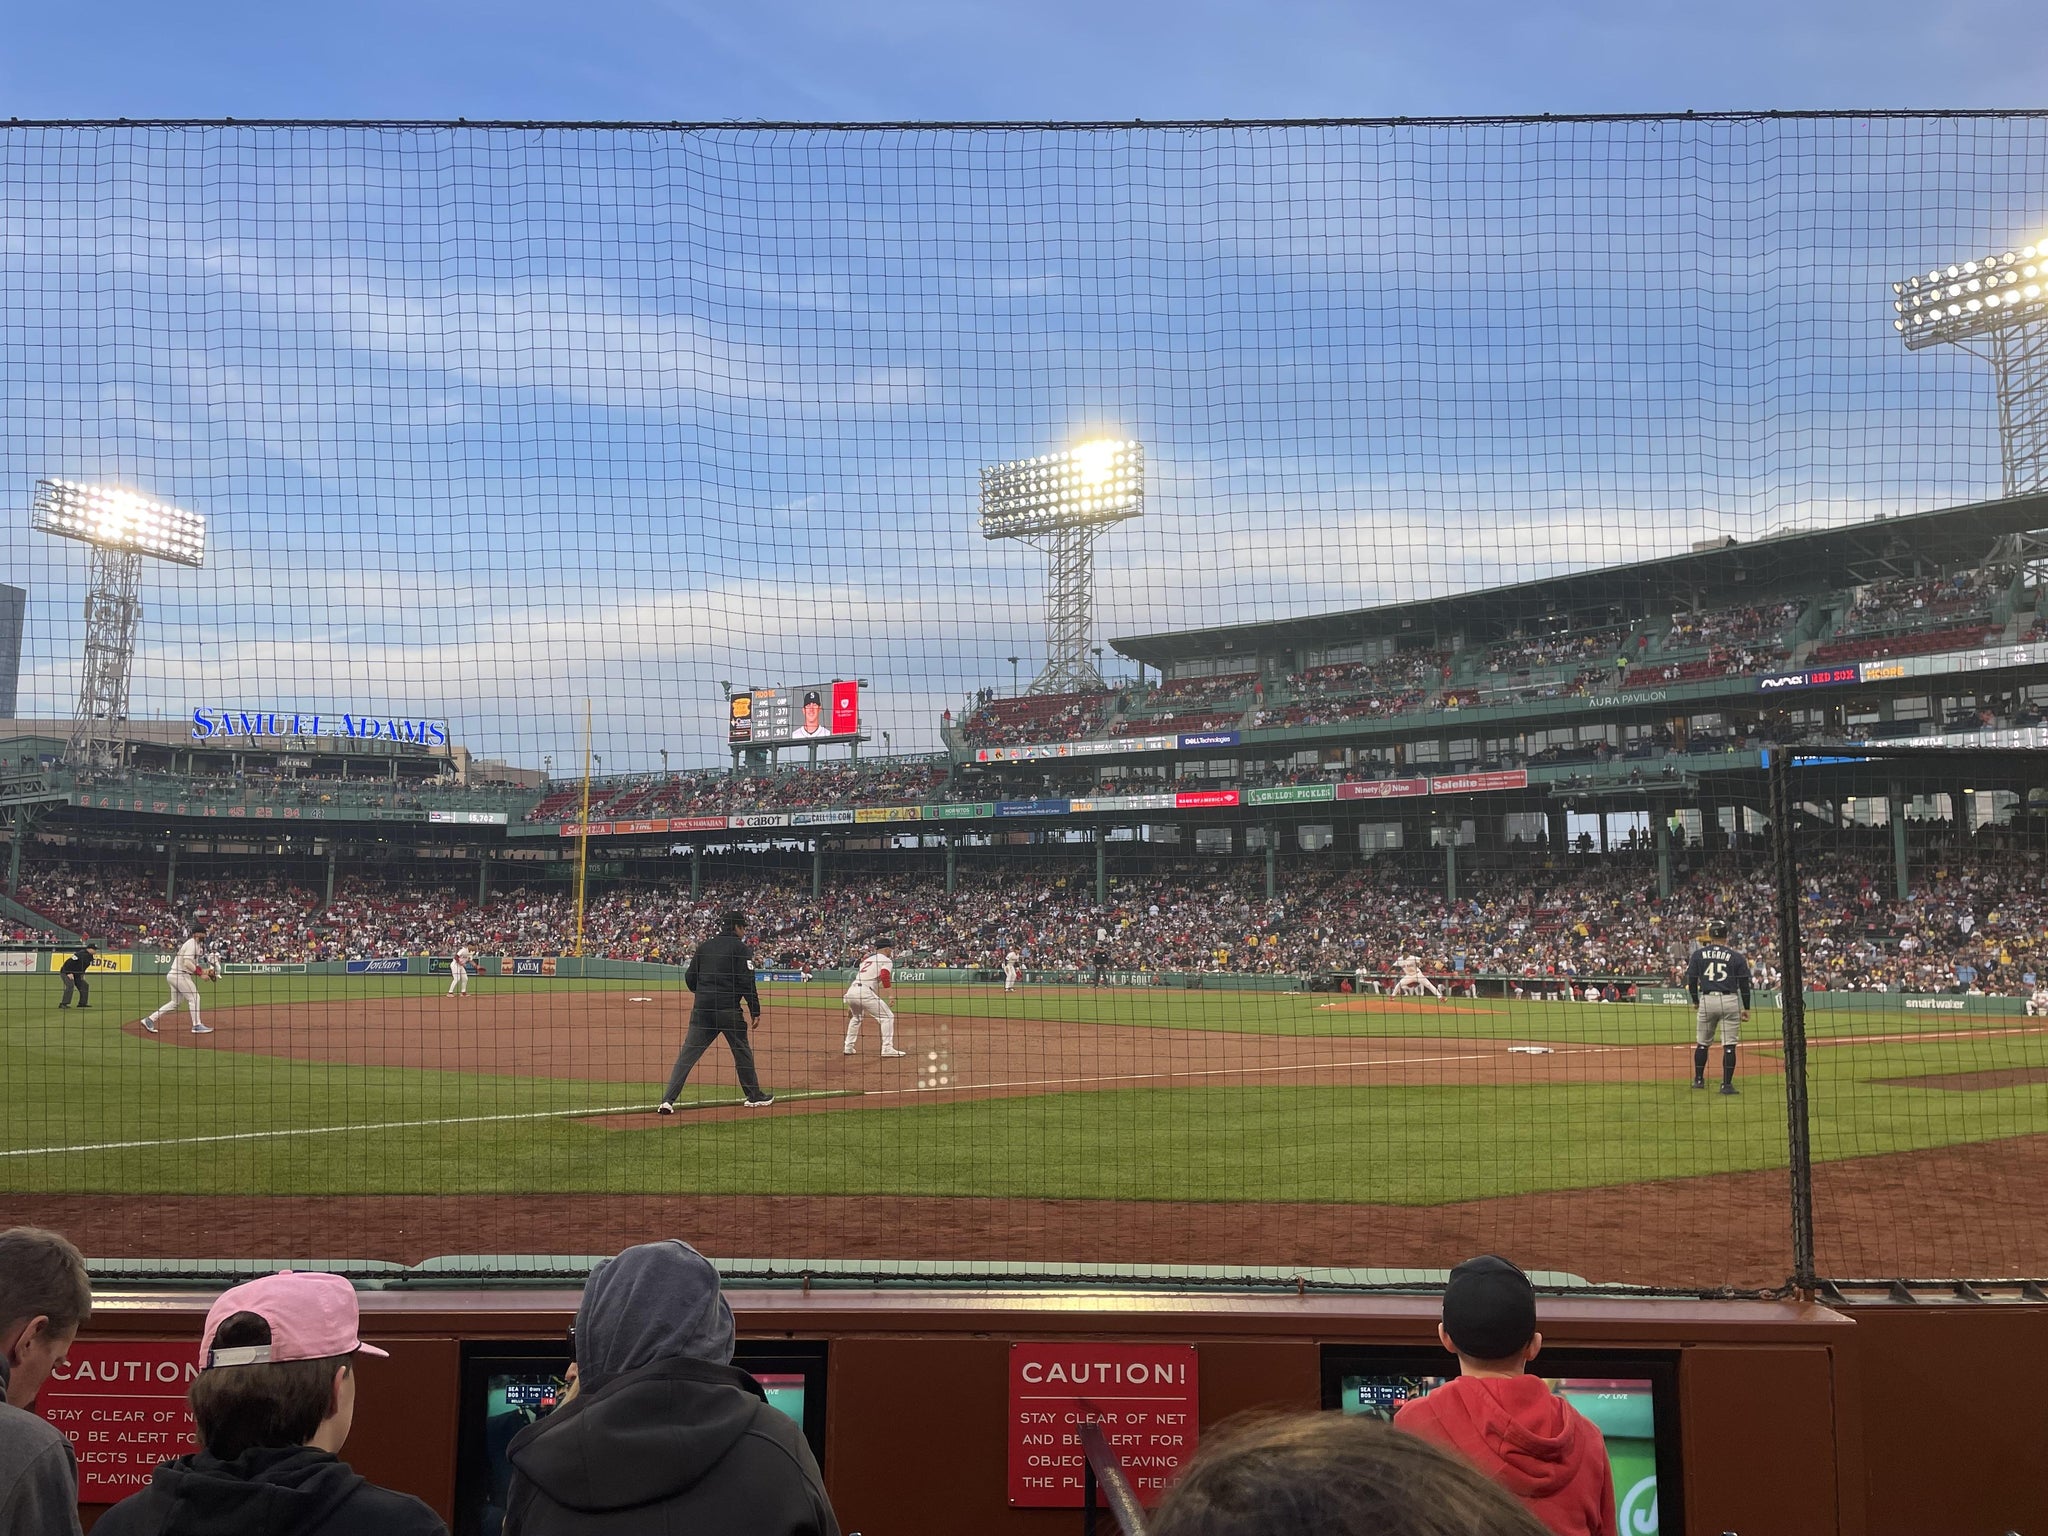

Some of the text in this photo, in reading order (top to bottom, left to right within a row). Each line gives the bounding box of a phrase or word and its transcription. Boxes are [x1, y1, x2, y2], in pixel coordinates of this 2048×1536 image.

[1811, 669, 1855, 683] RED SOX
[1865, 666, 1905, 679] MOORE
[1622, 691, 1667, 704] PAVILION
[756, 707, 788, 718] .316 .371
[191, 706, 447, 748] SAMUEL ADAMS
[1354, 784, 1410, 795] Ninety Nine
[1433, 780, 1478, 790] Safelite
[1297, 788, 1331, 798] PICKLES
[103, 959, 118, 971] TEA
[154, 954, 172, 964] 380
[364, 959, 402, 972] Jordan's
[516, 961, 540, 974] KAYEM
[859, 961, 873, 973] 2
[1703, 961, 1728, 982] 45
[1905, 998, 1965, 1010] smartwater
[51, 1360, 200, 1383] CAUTION
[1021, 1362, 1186, 1385] CAUTION!
[46, 1409, 84, 1421] STAY
[91, 1410, 145, 1422] CLEAR
[152, 1411, 176, 1422] OF
[1019, 1413, 1187, 1425] STAY CLEAR OF NET
[88, 1431, 110, 1442] BE
[117, 1432, 169, 1444] ALERT
[176, 1433, 197, 1444] FO
[1022, 1434, 1054, 1445] AND
[1062, 1434, 1083, 1445] BE
[1150, 1434, 1184, 1446] FOR
[76, 1452, 128, 1464] JECTS
[1027, 1455, 1179, 1467] OBJEC EAVING
[86, 1473, 153, 1485] PLAYING
[1022, 1477, 1055, 1488] THE
